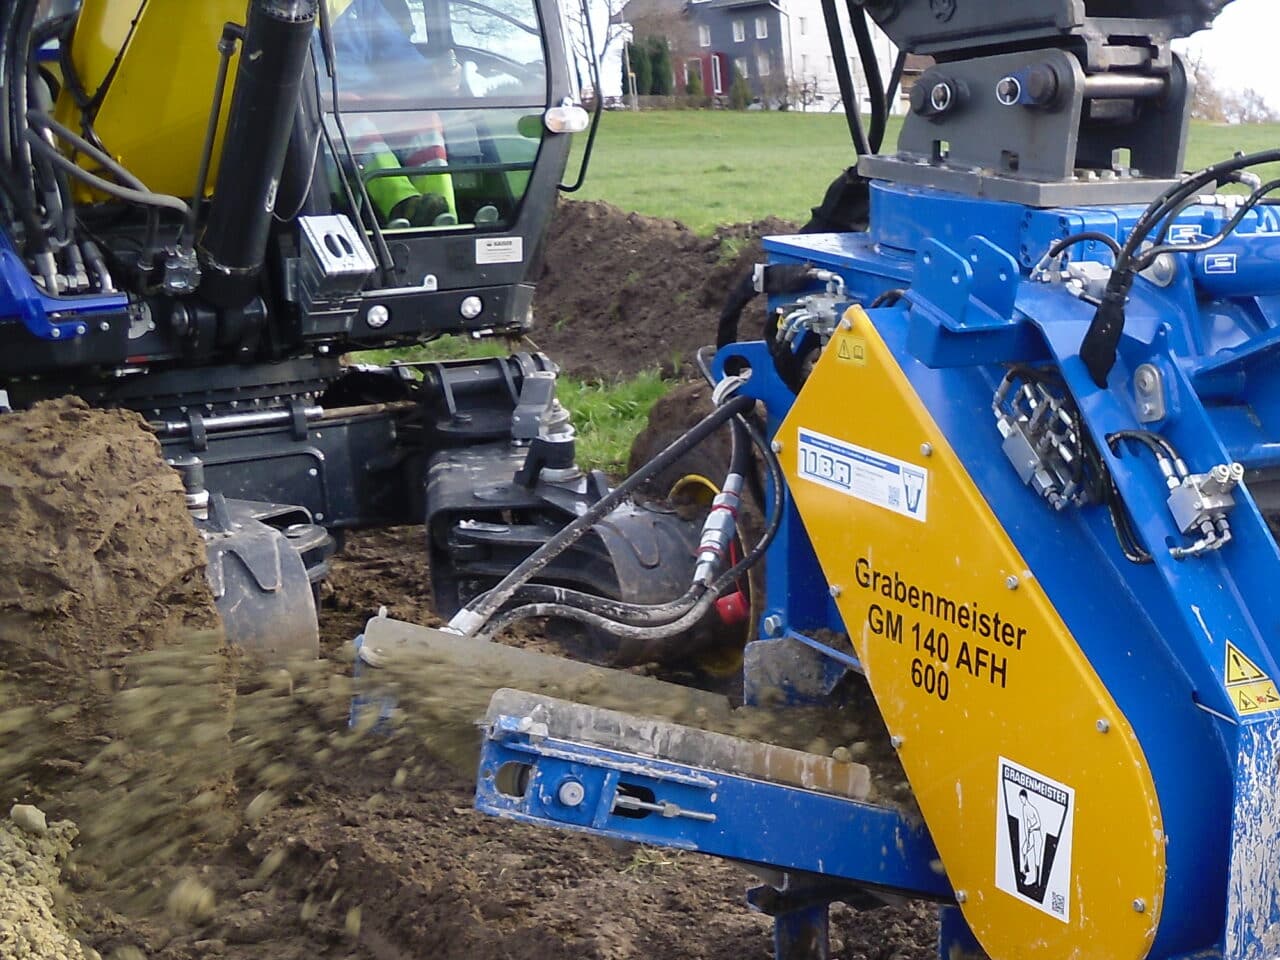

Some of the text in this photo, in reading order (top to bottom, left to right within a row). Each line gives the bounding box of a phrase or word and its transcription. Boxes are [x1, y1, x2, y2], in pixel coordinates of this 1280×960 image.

[855, 558, 1027, 650] Grabenmeister
[868, 604, 1007, 688] GM 140 AFH
[911, 658, 949, 701] 600
[1003, 765, 1067, 806] GRABENMEISTER
